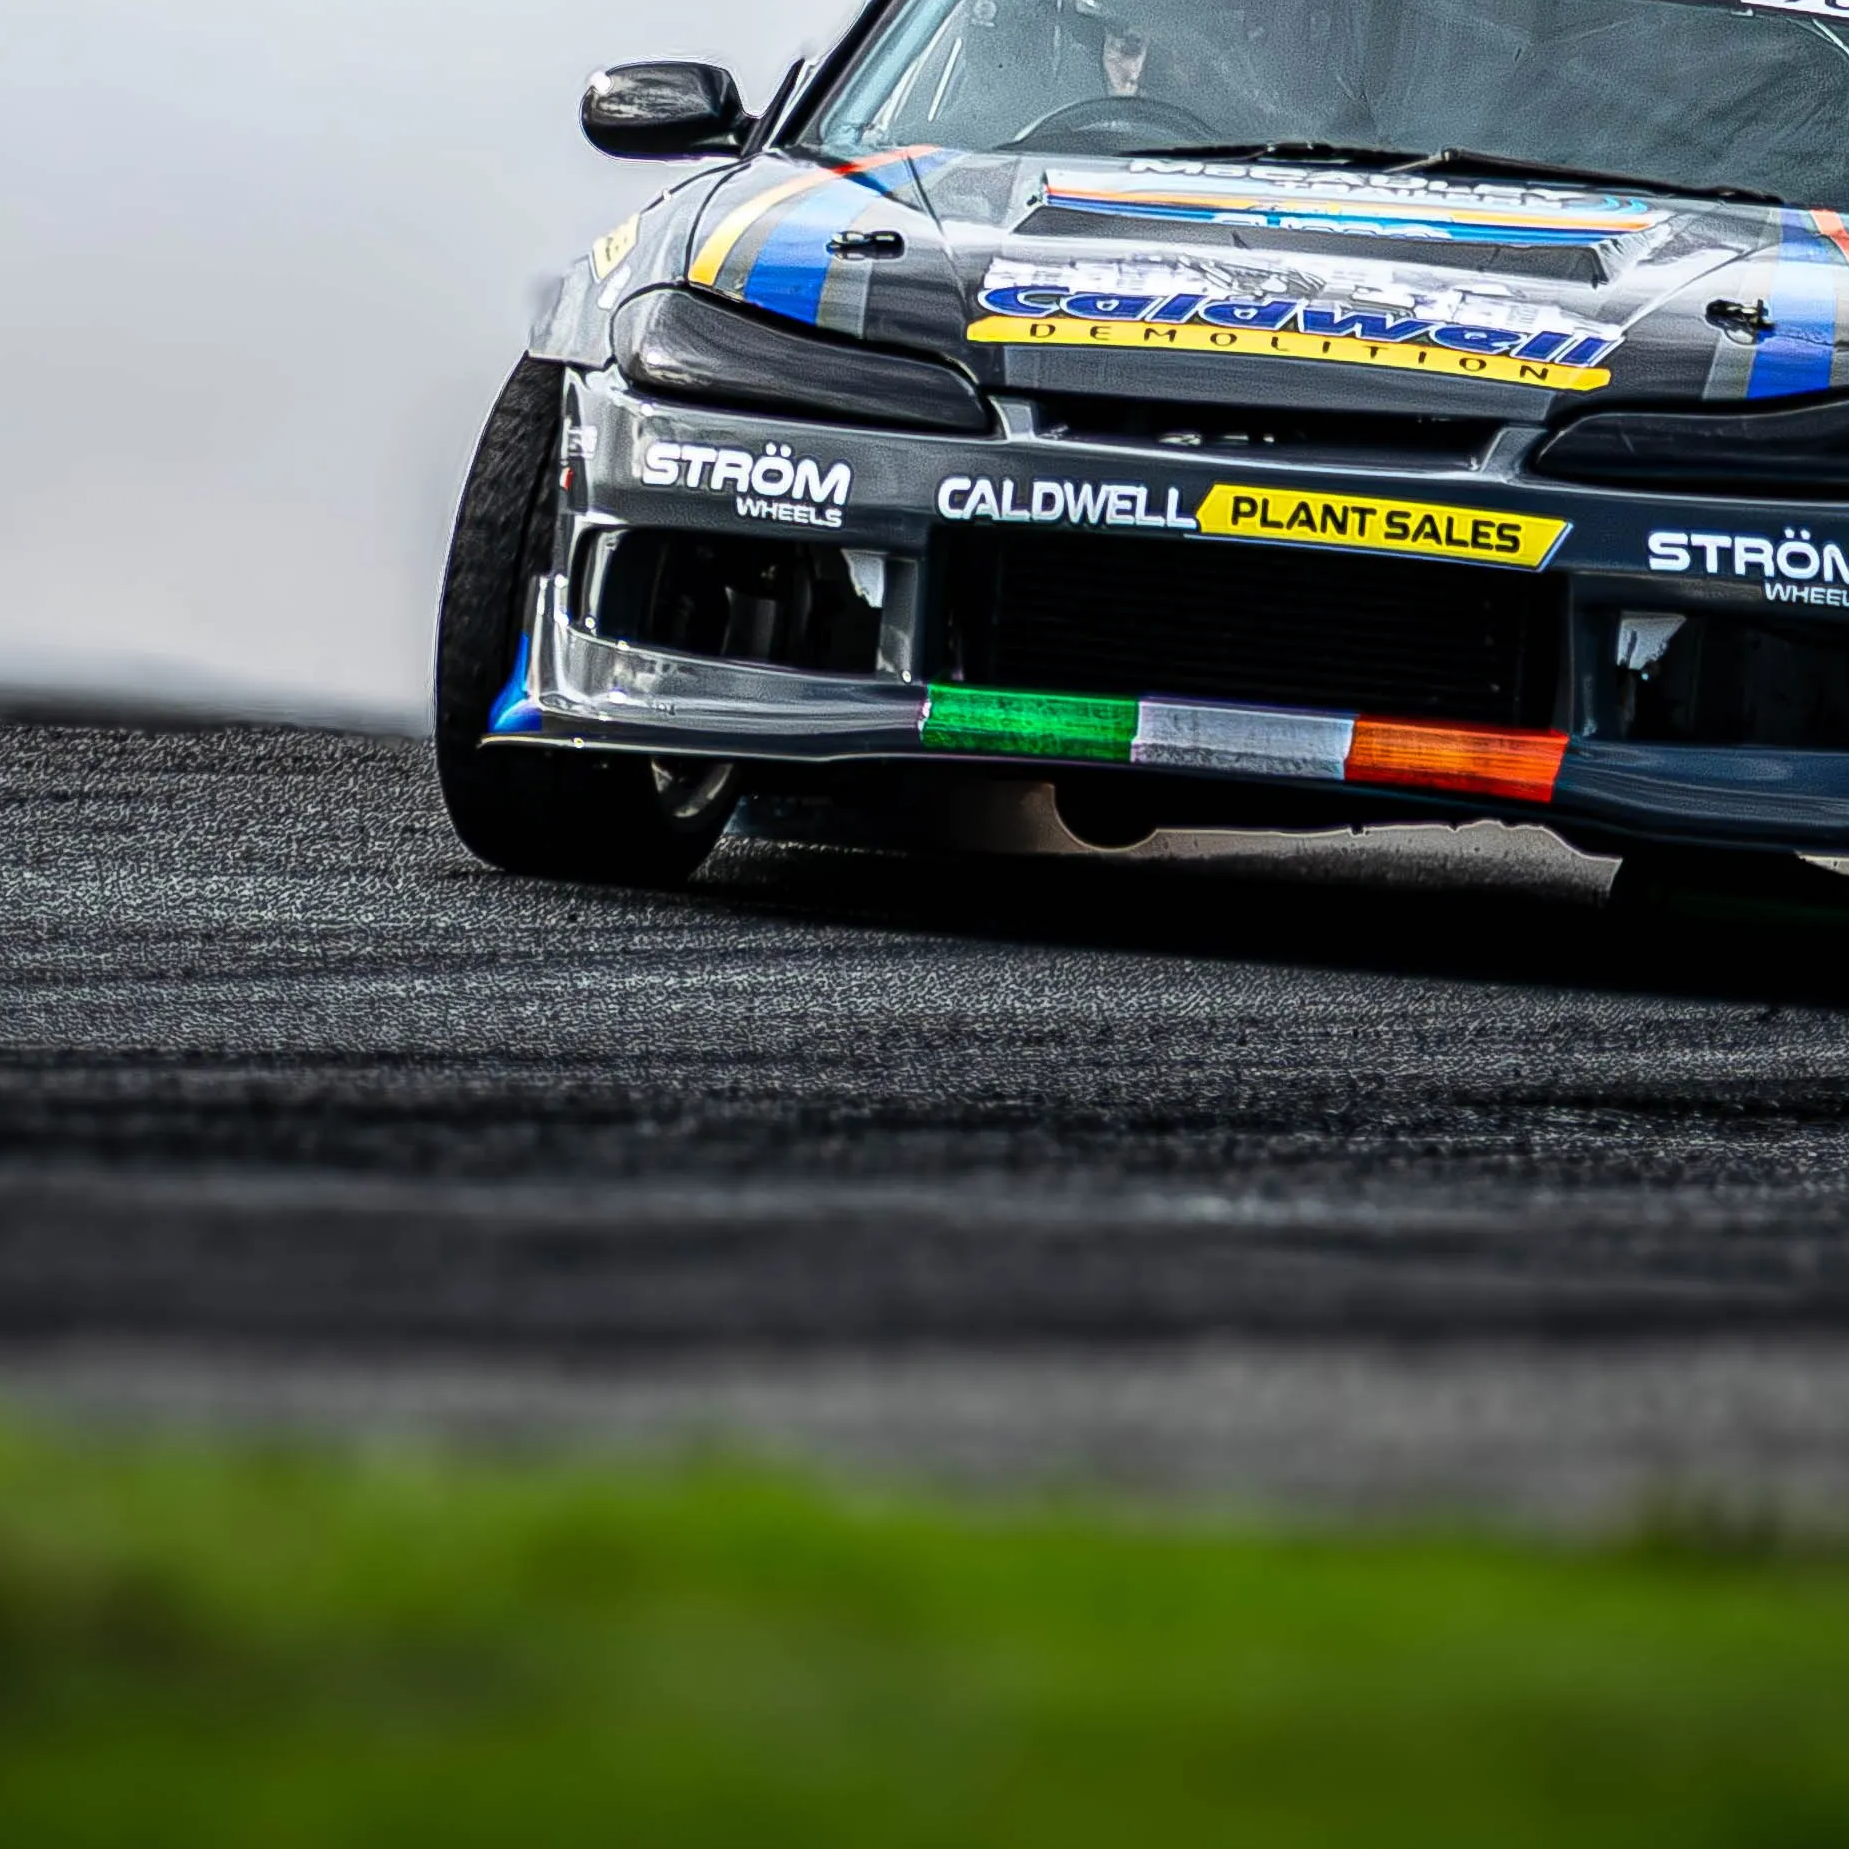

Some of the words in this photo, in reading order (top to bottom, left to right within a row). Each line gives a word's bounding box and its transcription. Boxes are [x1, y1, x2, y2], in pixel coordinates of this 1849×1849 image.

[1029, 322, 1549, 381] DEMOLITION
[641, 442, 852, 505] STRÖM
[736, 496, 843, 528] WHEELS
[936, 477, 1197, 530] CALDWELL
[1230, 495, 1379, 539] PLANT
[1383, 510, 1522, 553] SALES
